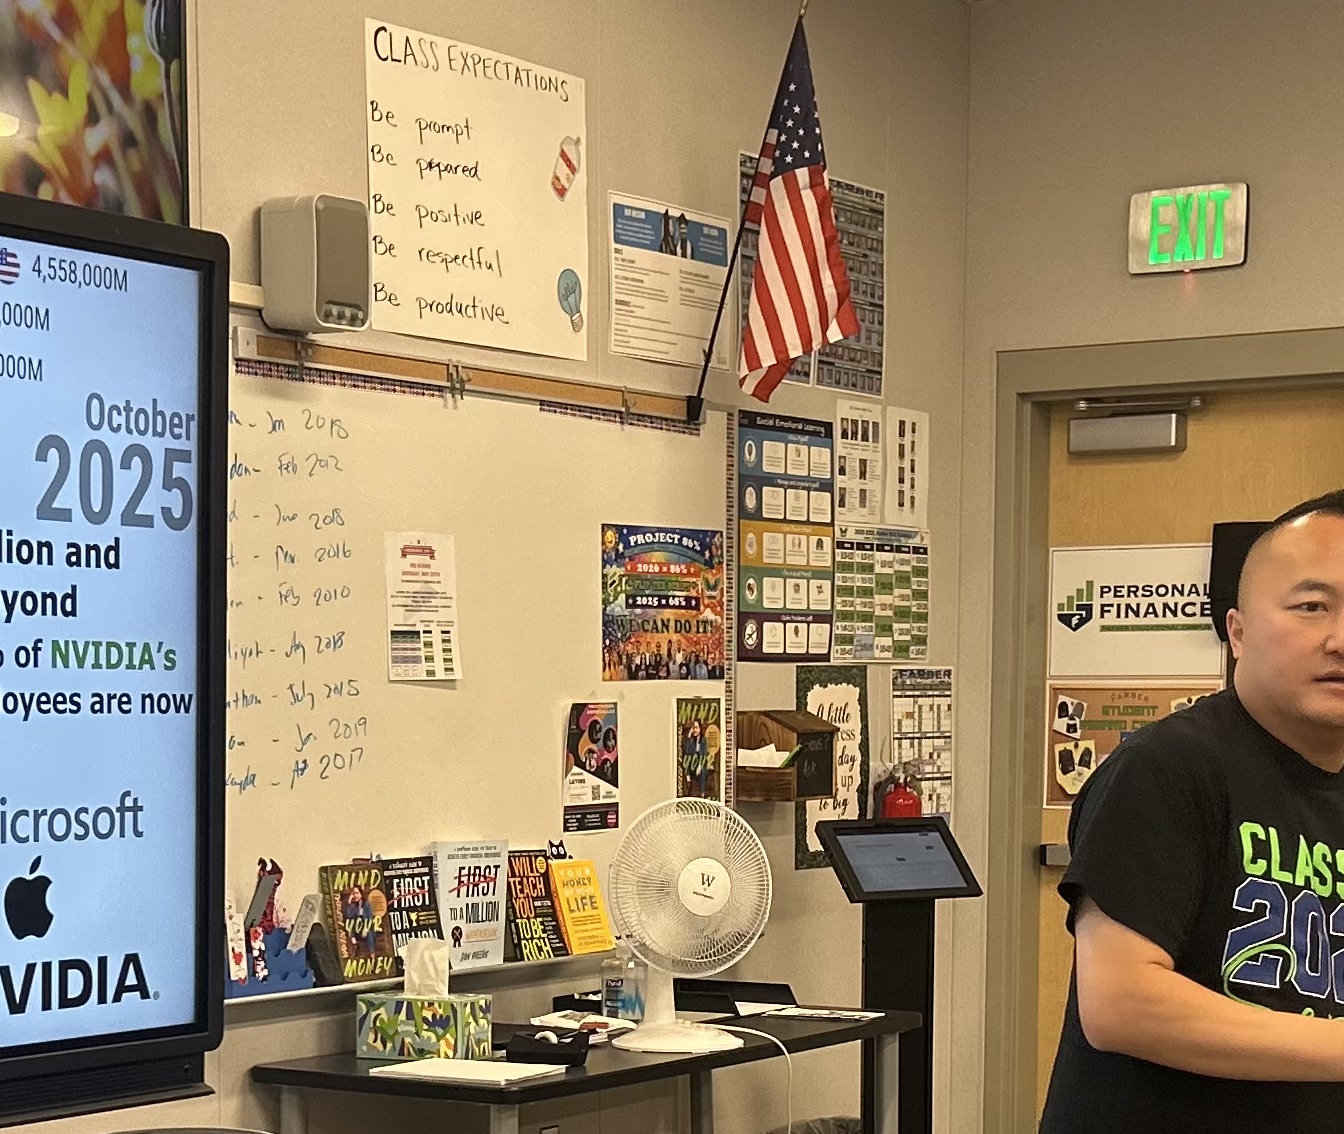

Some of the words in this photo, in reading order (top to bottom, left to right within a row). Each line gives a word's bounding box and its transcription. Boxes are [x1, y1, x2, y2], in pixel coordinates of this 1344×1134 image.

[373, 26, 439, 71] CLASS
[447, 45, 569, 102] EXPECTATIONS
[370, 100, 397, 127] Be
[415, 117, 473, 144] prompt
[370, 144, 397, 166] Be
[372, 193, 396, 216] Be
[415, 203, 485, 228] positive
[1148, 188, 1232, 265] EXIT
[372, 235, 397, 257] Be
[418, 247, 503, 278] respectful
[32, 254, 129, 293] 4,558,000M
[374, 283, 400, 306] Be
[416, 293, 509, 324] productive
[86, 392, 195, 443] October
[302, 408, 350, 439] 2018
[756, 416, 774, 427] Social
[35, 434, 195, 532] 2025
[629, 532, 681, 546] PROJECT
[681, 537, 701, 551] 86%
[65, 537, 121, 570] and
[636, 563, 660, 573] 2026
[313, 585, 351, 606] 2010
[636, 596, 658, 606] 2025
[1099, 583, 1211, 599] PERSONAL
[1099, 602, 1212, 619] FINANCE
[616, 618, 637, 634] WE
[641, 618, 670, 634] CAN
[674, 619, 692, 634] DO
[696, 619, 714, 634] IT!
[14, 638, 43, 669] of
[51, 639, 177, 672] NVIDIA's
[899, 669, 952, 681] FARBER
[90, 690, 132, 714] are
[140, 691, 193, 714] now
[678, 701, 719, 724] MIND
[827, 701, 852, 724] little
[329, 717, 368, 739] 2019
[319, 747, 364, 780] 2017
[838, 745, 858, 772] day
[841, 776, 853, 792] up
[511, 855, 540, 877] WILL
[334, 869, 381, 891] MIND
[457, 865, 500, 898] FIRST
[508, 876, 545, 898] TEACH
[393, 876, 430, 908] FIRST
[466, 901, 500, 924] MILLION
[513, 897, 535, 918] YOU
[566, 895, 599, 913] LIFE
[345, 915, 383, 938] YOUR
[389, 911, 402, 930] TO
[402, 910, 410, 929] A
[516, 918, 532, 939] TO
[531, 918, 548, 938] BE
[521, 938, 554, 962] RICH
[344, 956, 393, 978] MONEY
